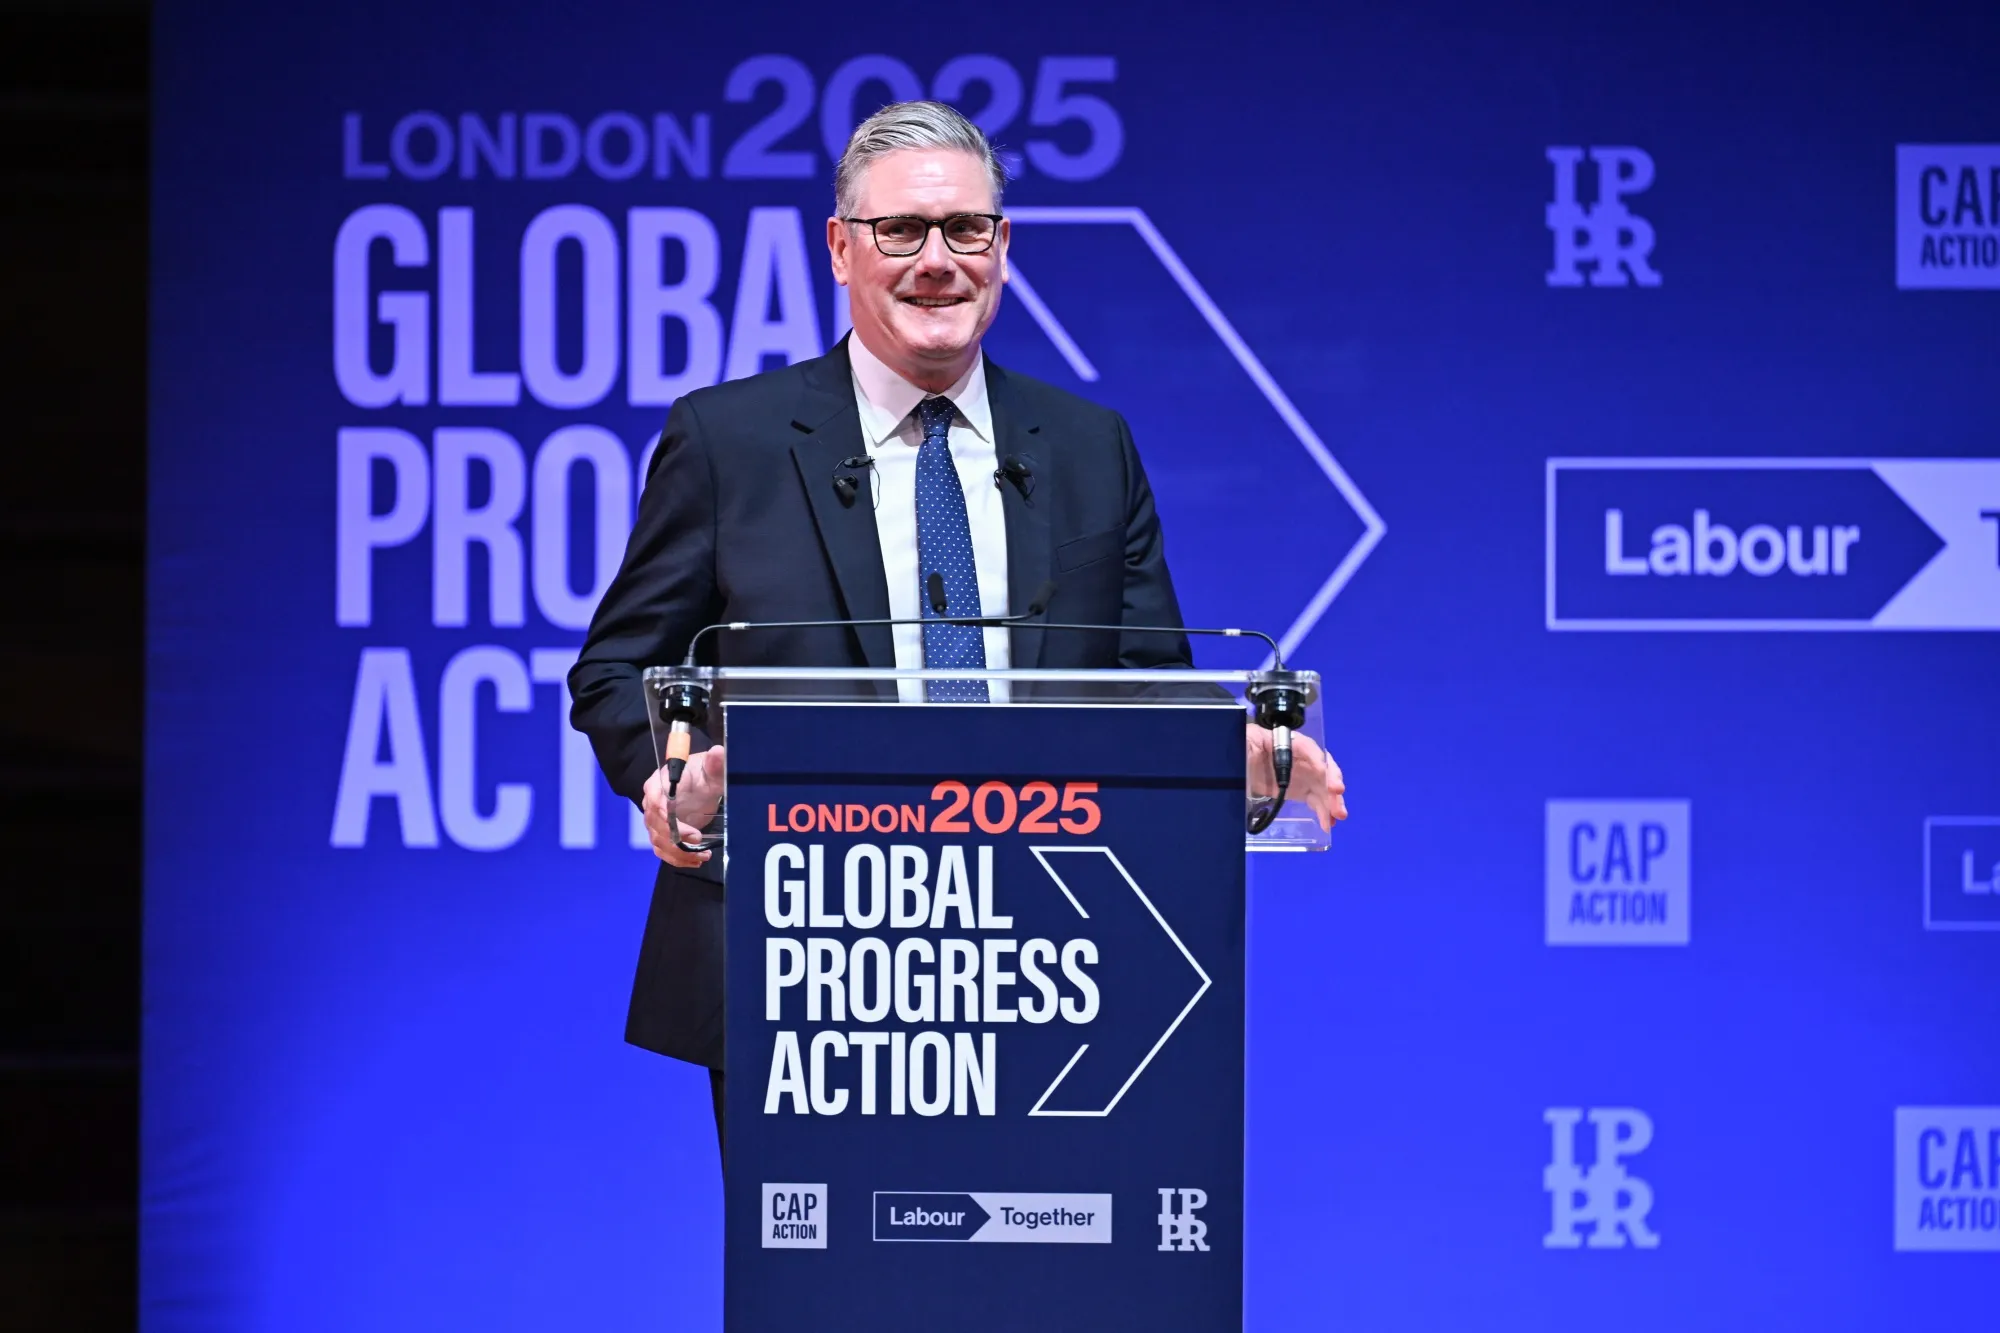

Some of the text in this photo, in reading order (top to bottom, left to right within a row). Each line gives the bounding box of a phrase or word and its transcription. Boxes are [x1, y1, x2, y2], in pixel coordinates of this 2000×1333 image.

[343, 112, 711, 181] LONDON
[333, 204, 850, 408] GLOBA
[336, 426, 664, 630] PRO
[1605, 509, 1860, 576] Labour
[768, 779, 1102, 835] LONDON 2025
[1569, 821, 1669, 884] CAP
[764, 842, 1014, 930] GLOBAL
[1569, 890, 1668, 926] ACTION
[765, 936, 1100, 1025] PROGRESS
[763, 1030, 997, 1117] ACTION
[772, 1192, 818, 1221] CAP
[772, 1223, 817, 1240] ACTION
[890, 1206, 1095, 1230] Labour Together
[1918, 1196, 2000, 1232] ACTIO
